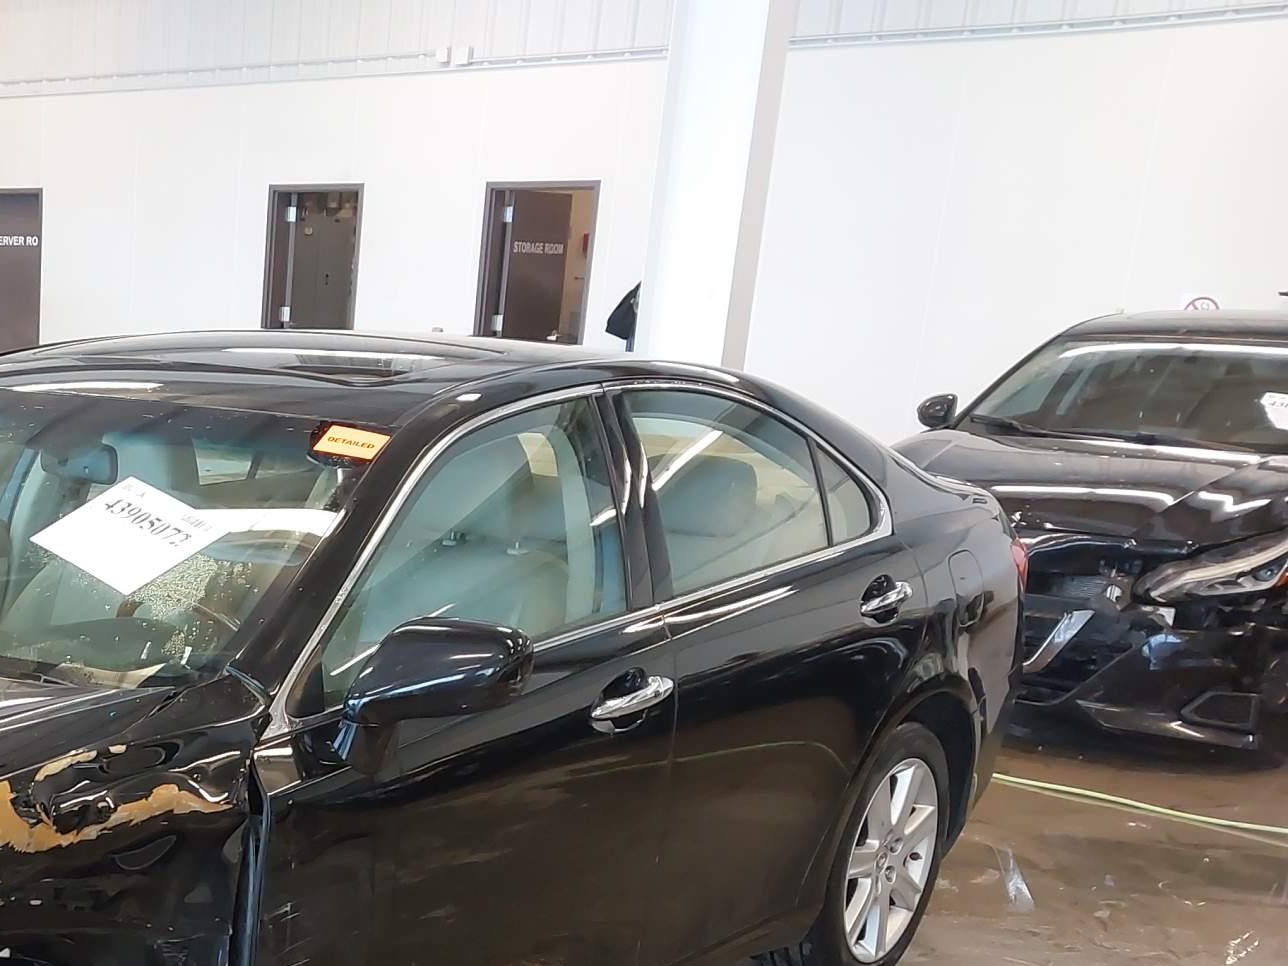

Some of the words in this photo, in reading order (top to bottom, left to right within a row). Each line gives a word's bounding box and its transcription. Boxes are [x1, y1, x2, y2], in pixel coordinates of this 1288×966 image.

[25, 235, 39, 246] RO
[327, 436, 375, 449] DETAILED
[104, 498, 192, 547] 43905072
